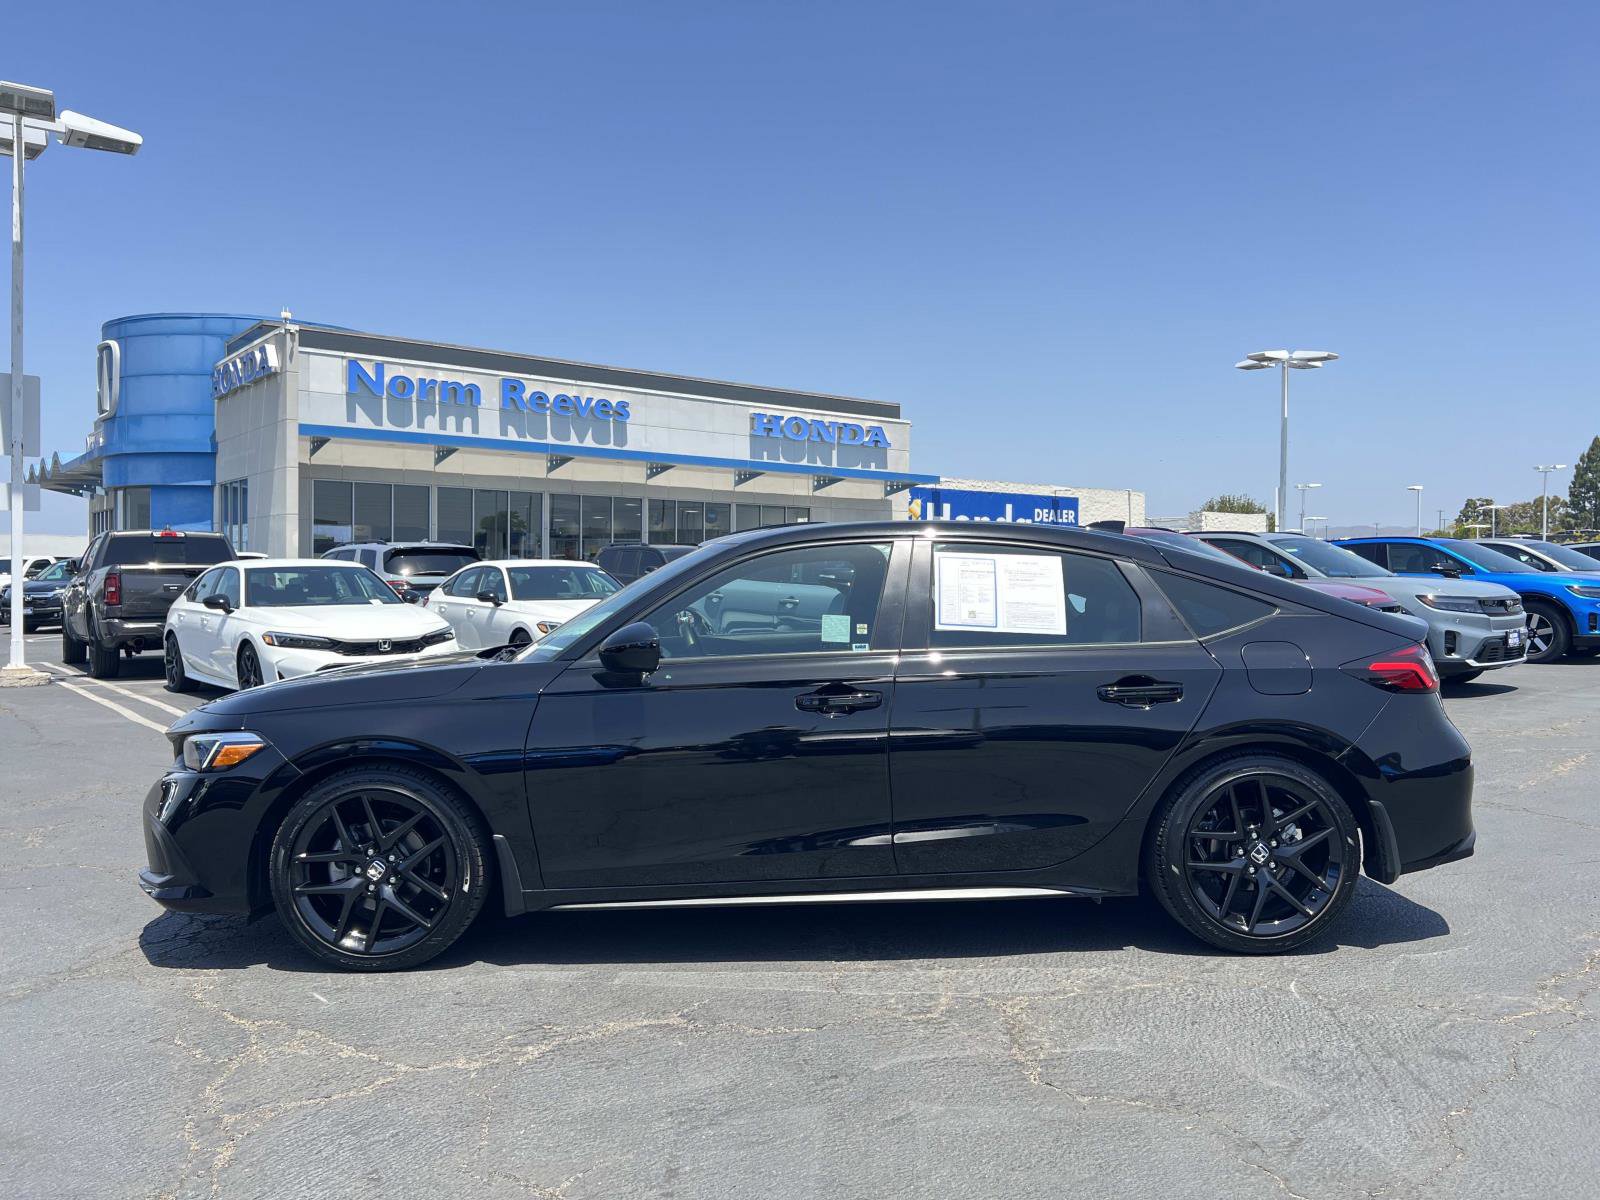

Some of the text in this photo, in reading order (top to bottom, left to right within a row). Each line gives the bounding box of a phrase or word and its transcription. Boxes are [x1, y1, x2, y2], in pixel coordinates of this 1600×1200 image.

[211, 343, 275, 398] HONDA
[346, 359, 631, 421] Norm Reeves
[752, 412, 892, 448] HONDA
[1034, 508, 1075, 524] DEALER
